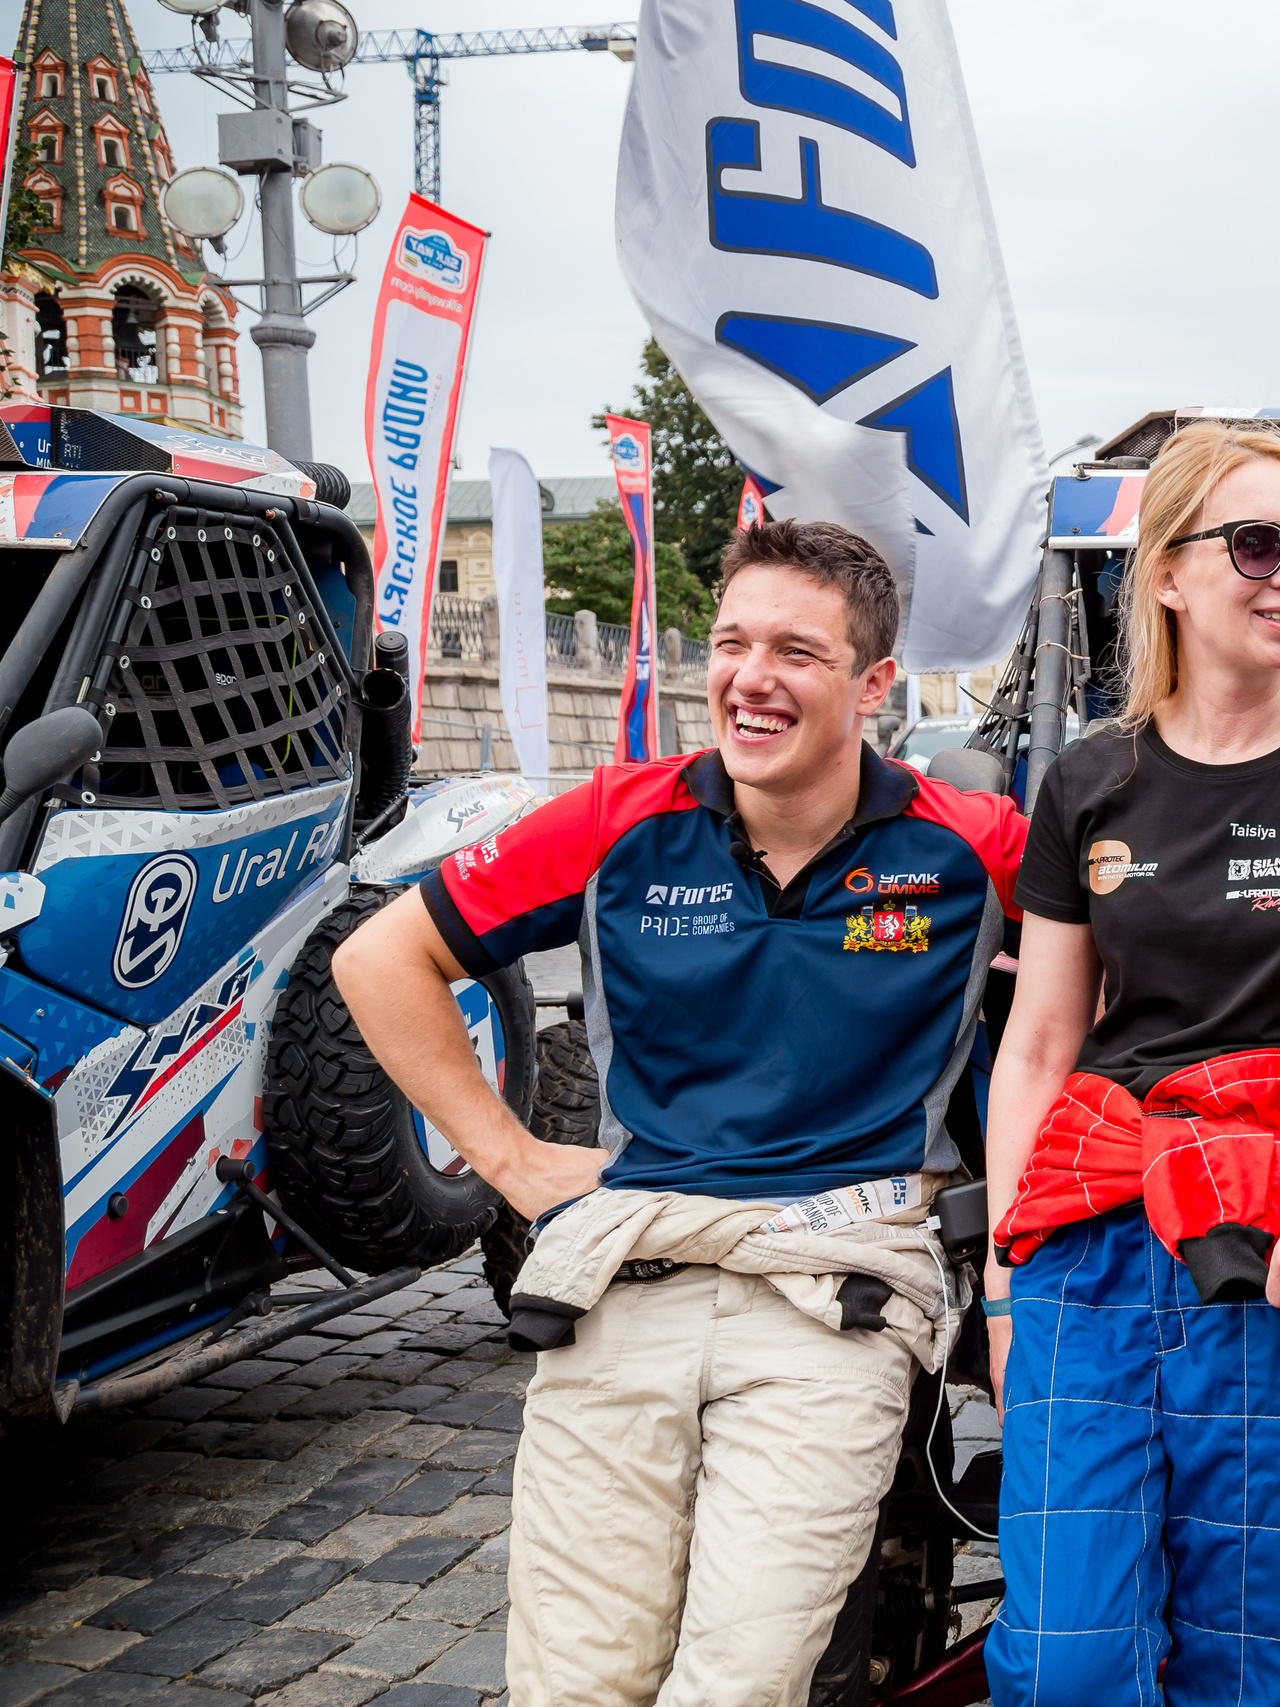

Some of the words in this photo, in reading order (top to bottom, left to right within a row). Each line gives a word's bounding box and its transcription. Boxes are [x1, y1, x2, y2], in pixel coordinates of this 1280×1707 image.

[1229, 822, 1277, 841] Taisiya
[212, 829, 300, 904] Ural
[1124, 871, 1146, 879] MOTOR
[878, 873, 940, 884] УГМК
[668, 882, 734, 906] Fores
[877, 883, 940, 895] UMMC
[640, 915, 690, 937] PRIDE
[692, 914, 718, 926] GROUP
[719, 912, 729, 923] OF
[692, 921, 736, 936] COMPANIES
[162, 1022, 220, 1085] RACING
